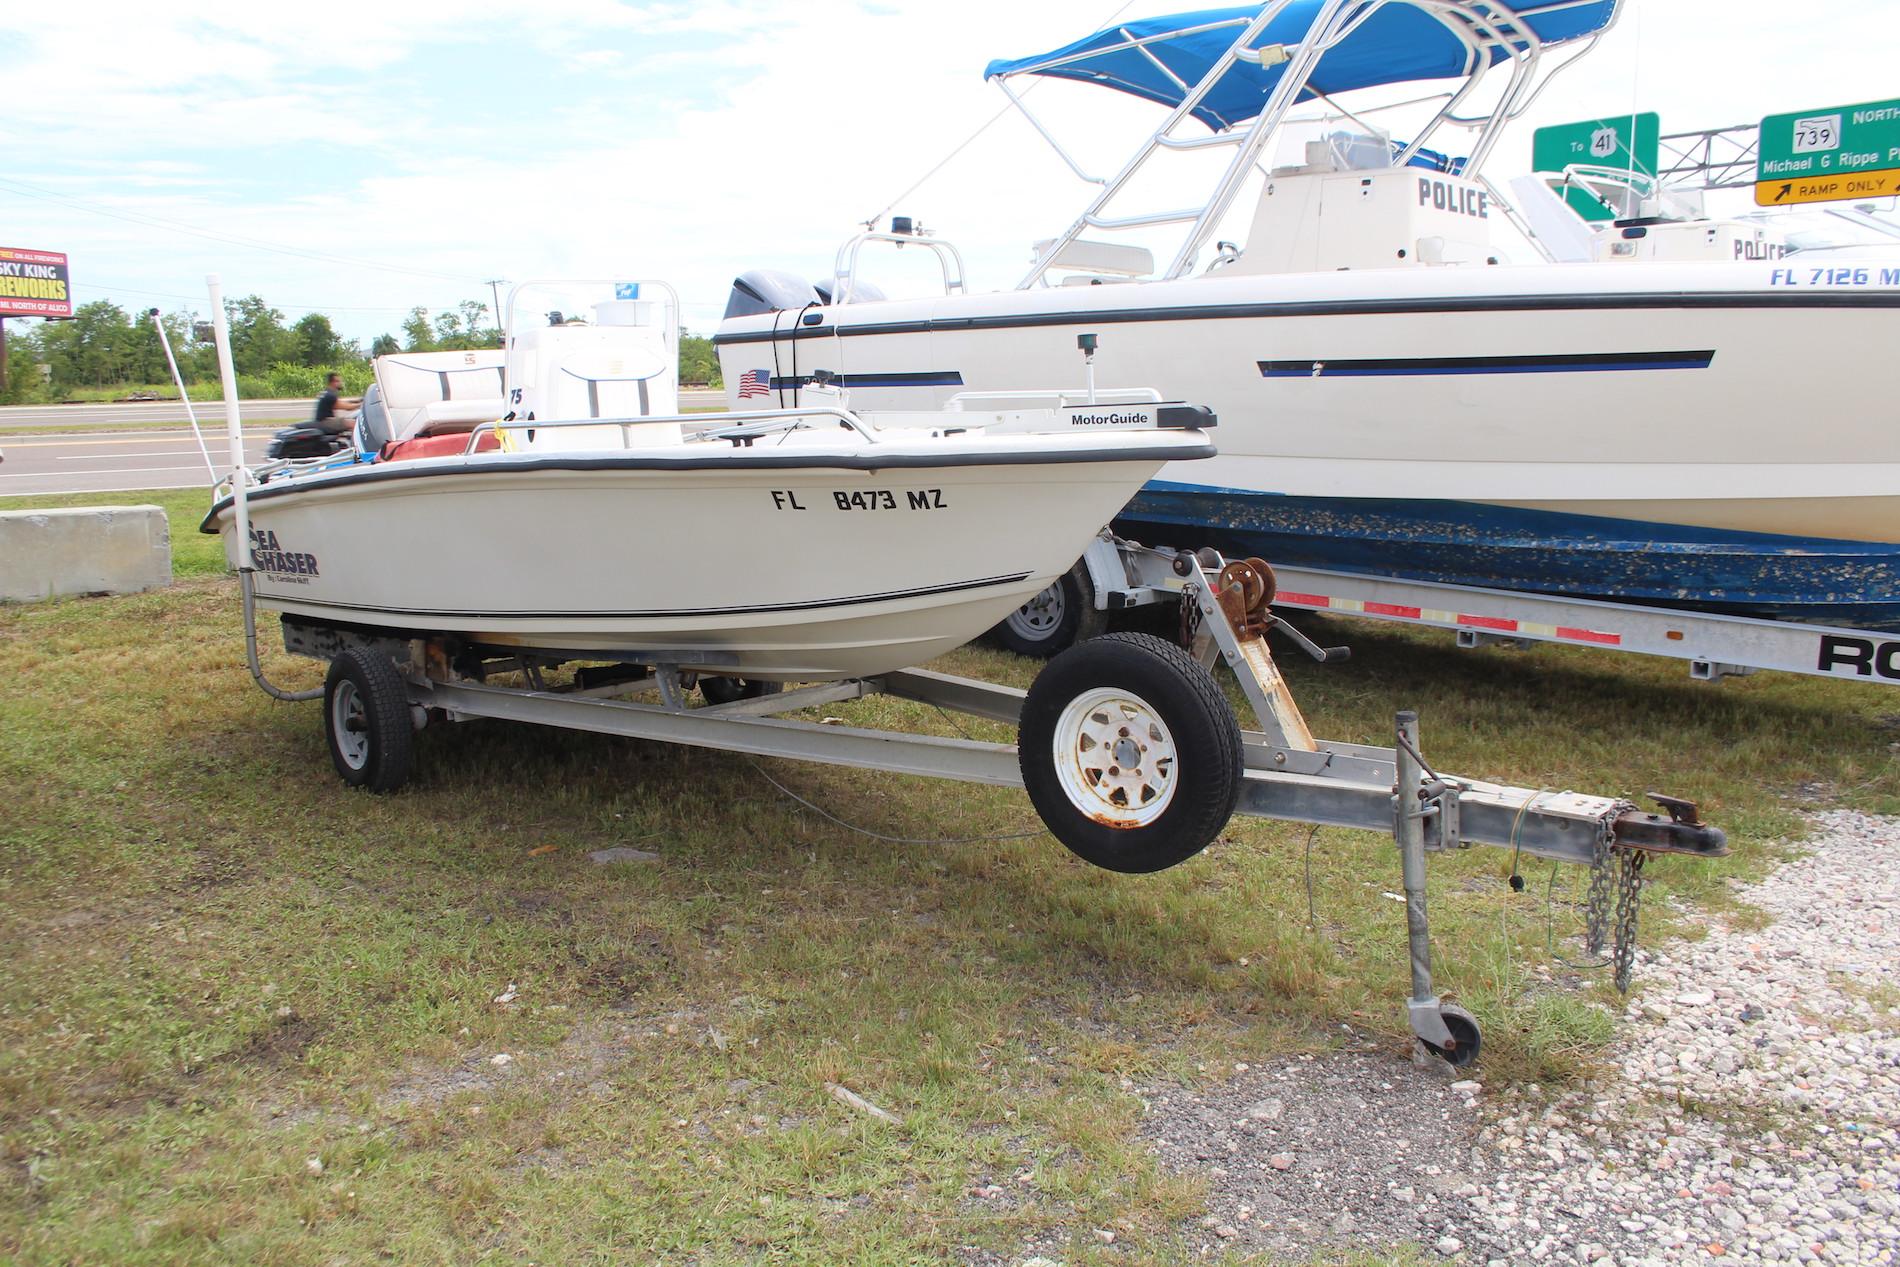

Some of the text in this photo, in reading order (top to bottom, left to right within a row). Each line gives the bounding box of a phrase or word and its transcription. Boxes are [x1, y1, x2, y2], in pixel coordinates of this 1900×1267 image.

[1595, 134, 1611, 151] 41
[1795, 129, 1831, 147] 739
[1570, 141, 1584, 153] To
[1763, 157, 1812, 173] Michael
[1821, 154, 1831, 168] G
[1839, 152, 1879, 167] Rippe
[1799, 179, 1886, 197] RAMP ONLY
[1418, 178, 1488, 219] POLICE
[24, 263, 57, 279] KING
[1770, 269, 1797, 285] FL
[1810, 268, 1869, 285] 7126
[37, 303, 48, 311] OF
[1072, 413, 1148, 425] MotorGuide
[771, 489, 948, 510] FL 8473 MZ
[250, 550, 320, 575] CHASER
